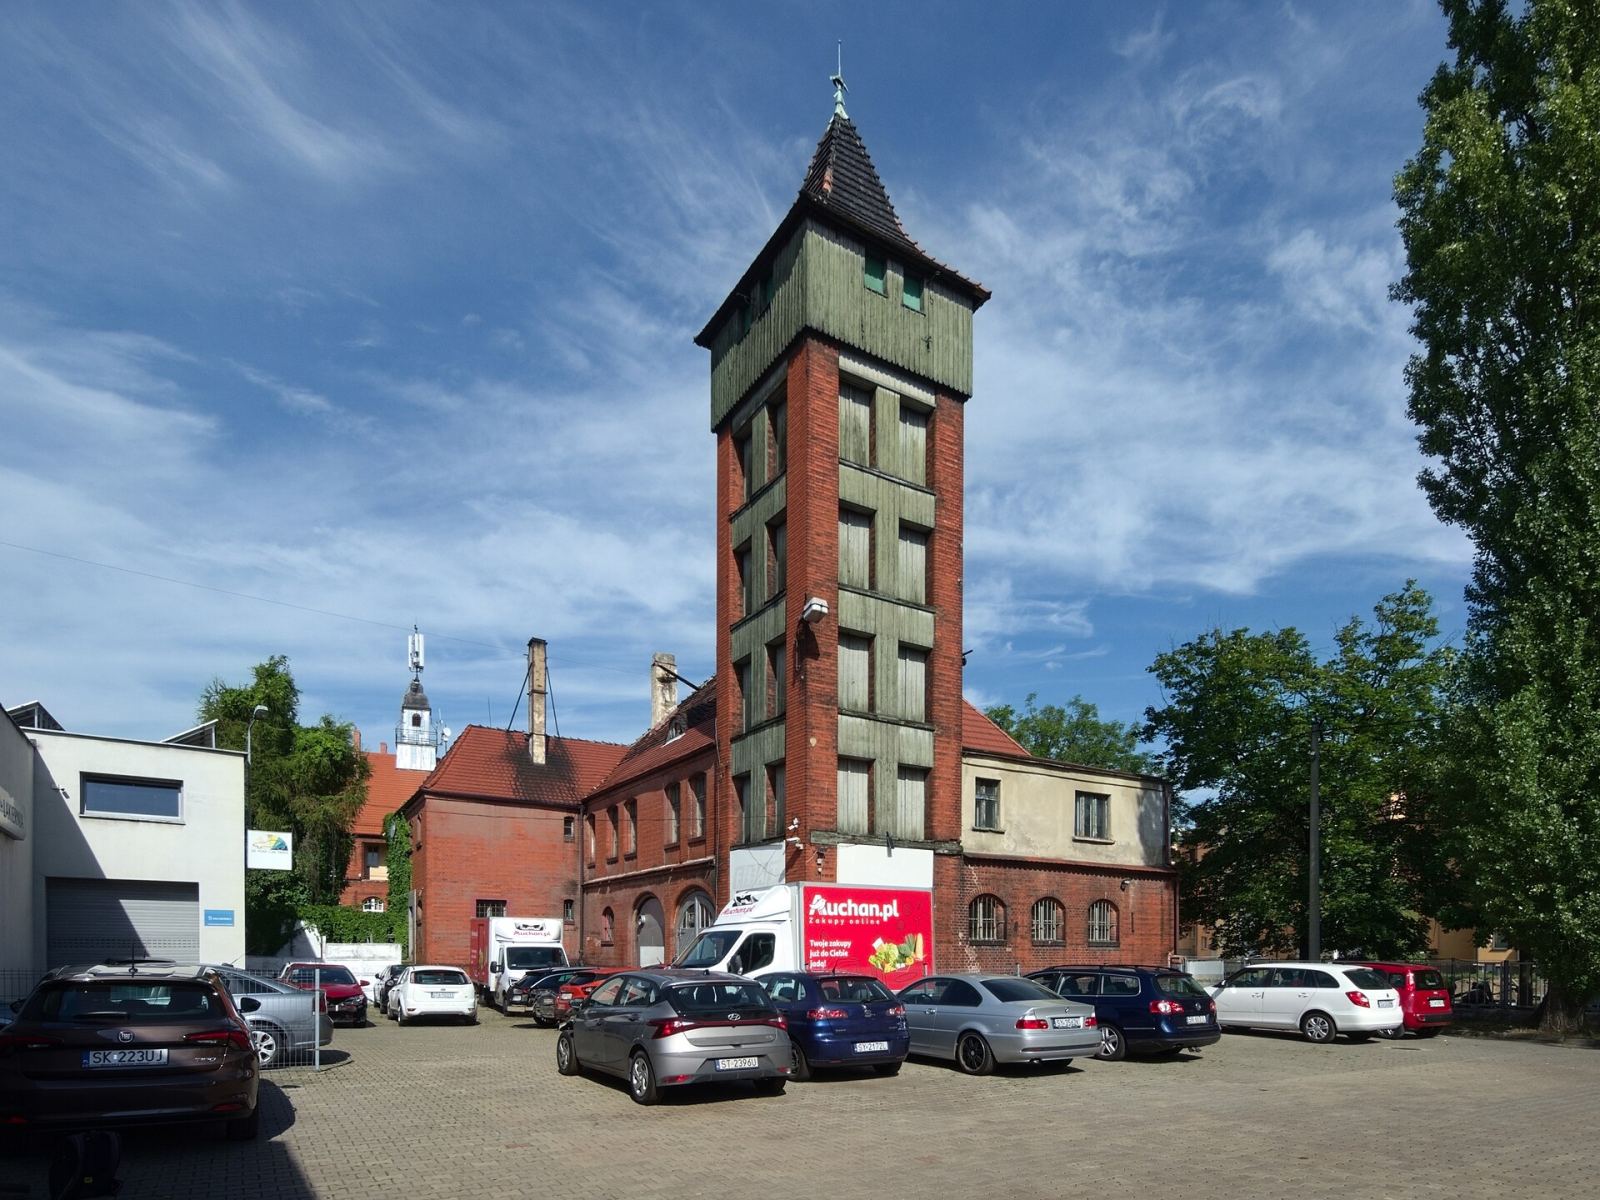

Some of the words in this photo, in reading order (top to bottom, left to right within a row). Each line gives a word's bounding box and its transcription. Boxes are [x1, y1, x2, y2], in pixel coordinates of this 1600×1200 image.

[809, 894, 899, 922] Auchan.pl
[809, 917, 845, 926] Zakupy
[809, 939, 829, 949] Twoje
[829, 940, 852, 949] zakupy
[820, 949, 829, 957] do
[830, 949, 849, 957] Ciebie
[92, 1051, 112, 1064] SK
[118, 1050, 163, 1063] 223UJ
[721, 1060, 731, 1068] ST
[734, 1058, 757, 1067] 2396U
